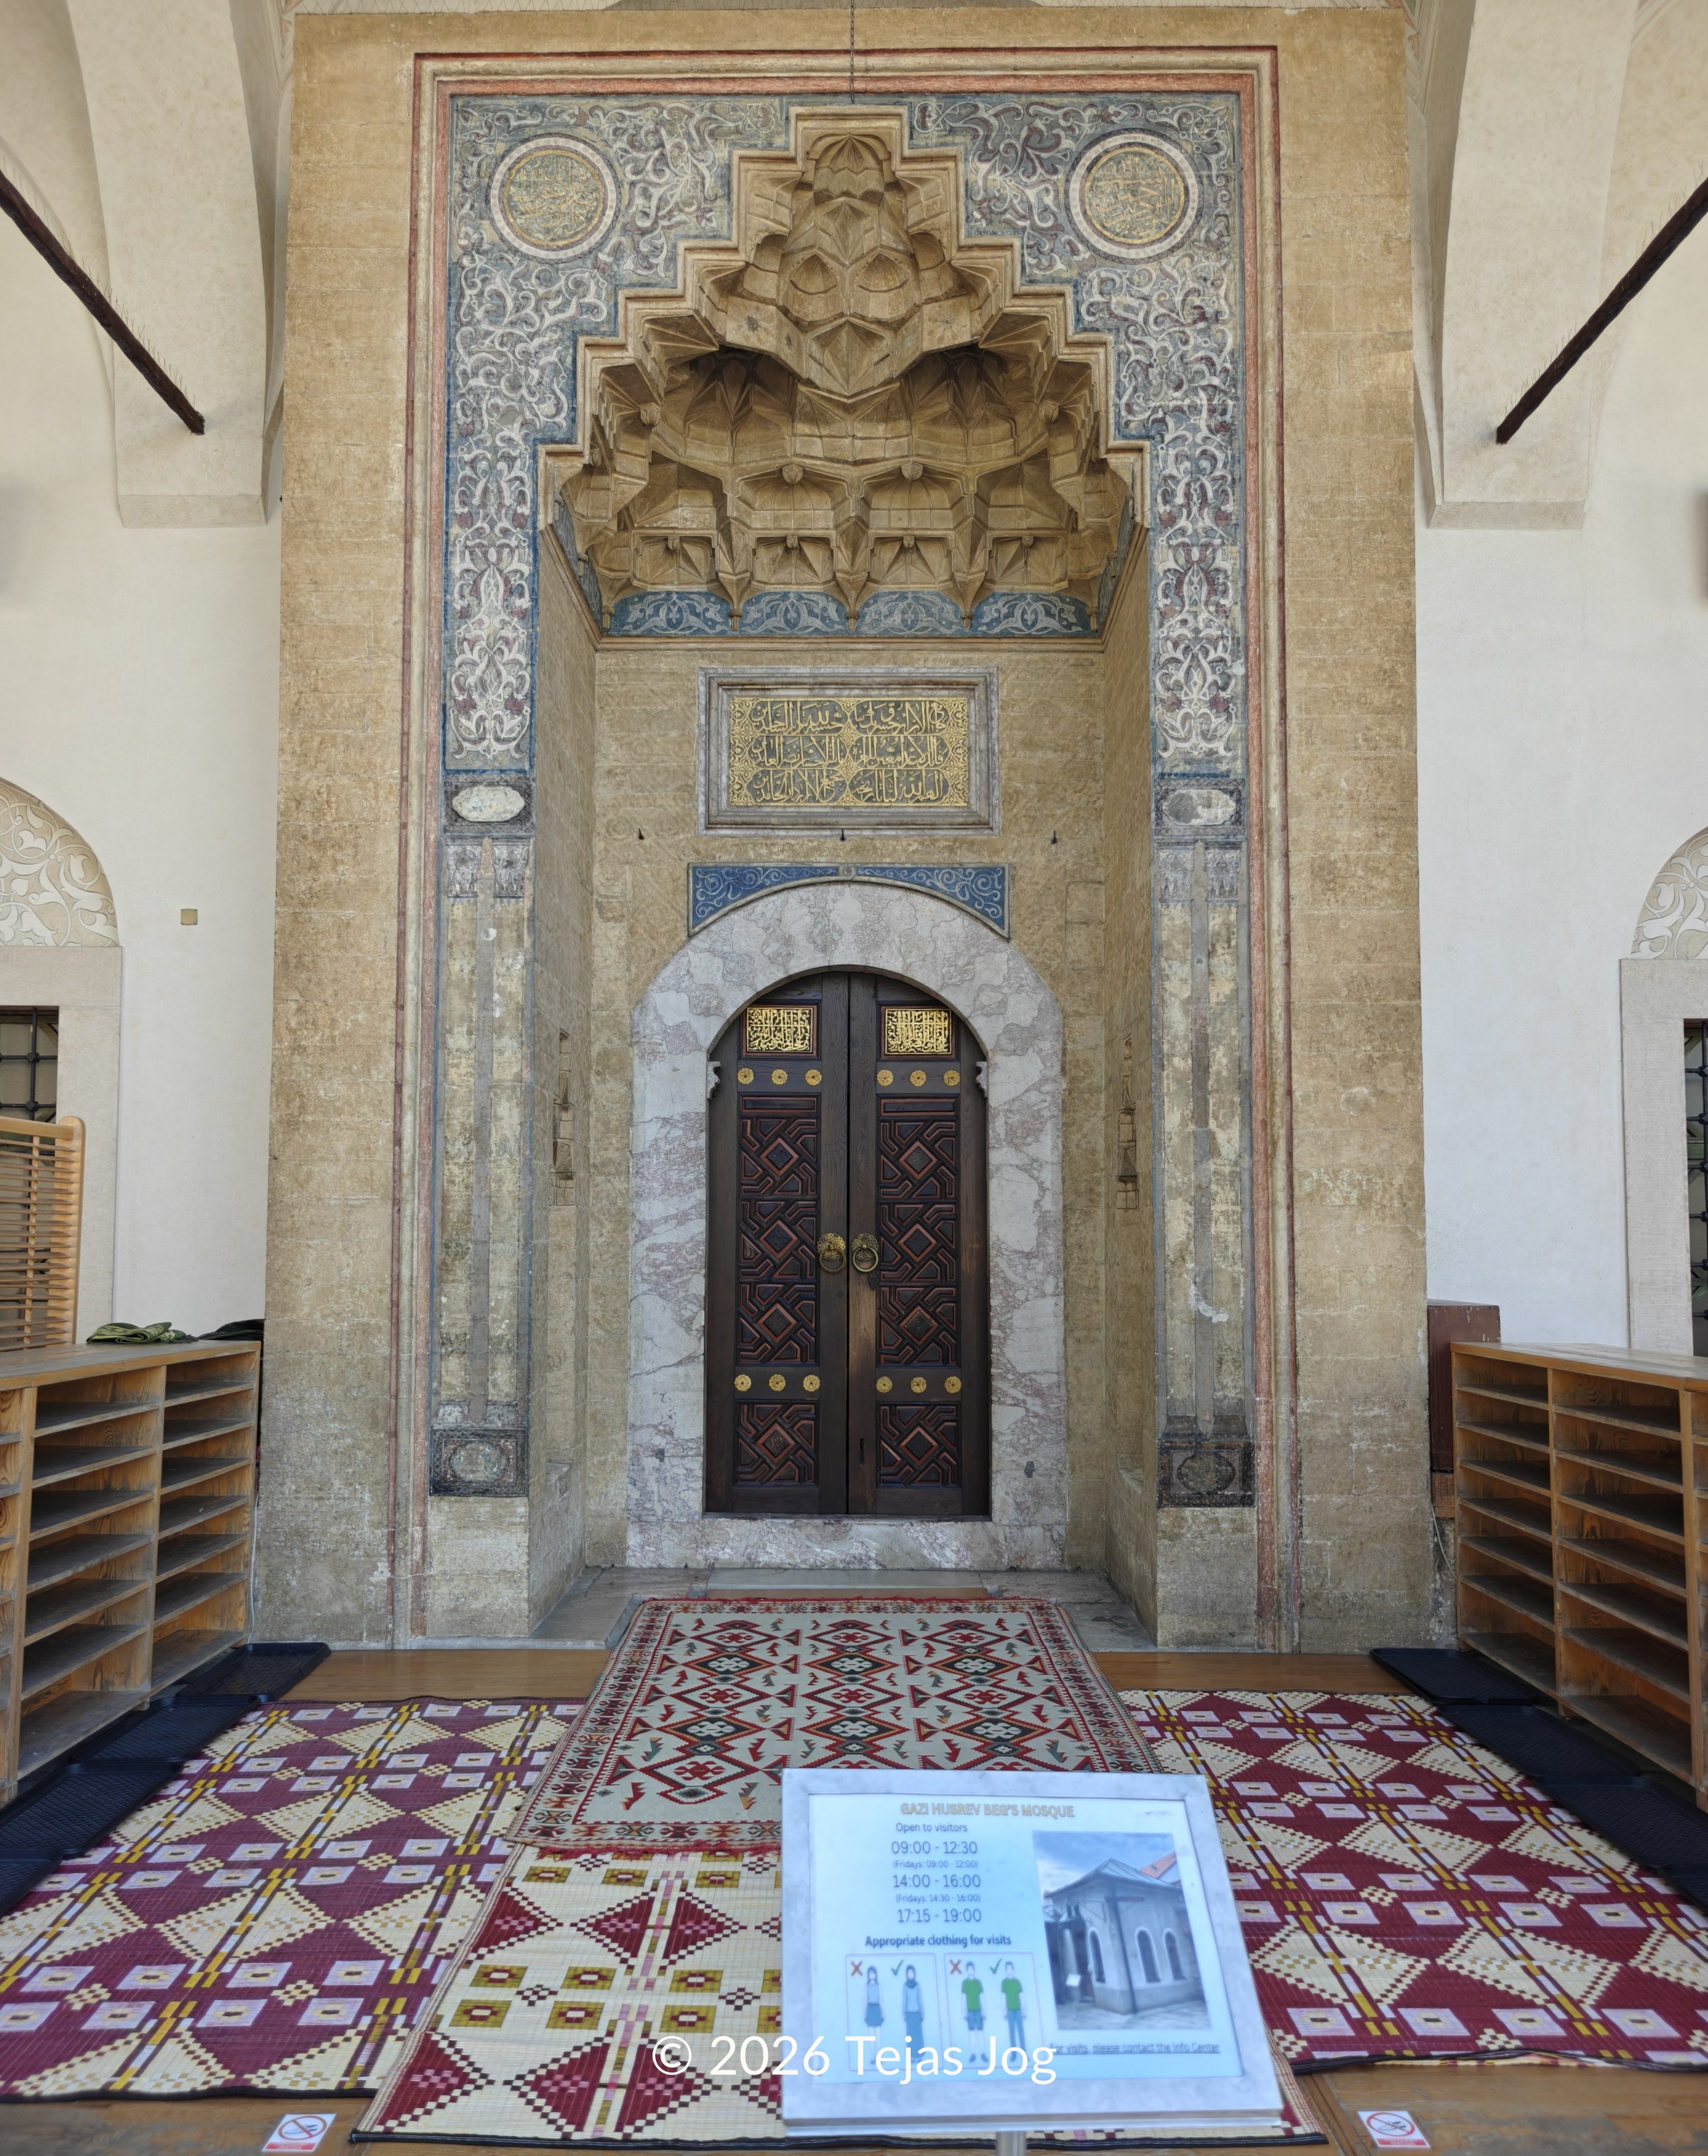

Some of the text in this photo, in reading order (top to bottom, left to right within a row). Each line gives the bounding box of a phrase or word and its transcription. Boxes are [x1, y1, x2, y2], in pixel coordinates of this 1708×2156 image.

[901, 1802, 1075, 1819] GAZI HUSREV BEG'S MOSQUE
[896, 1822, 967, 1833] Open to visitors
[891, 1840, 931, 1854] 09:00
[943, 1840, 977, 1854] 12:30
[893, 1860, 924, 1869] (Fridays:
[926, 1860, 949, 1868] 09:00
[955, 1860, 978, 1868] 12:00)
[893, 1874, 931, 1887] 14:00
[943, 1874, 981, 1887] 16:00
[896, 1894, 927, 1904] (Fridays:
[929, 1894, 950, 1902] 14:30
[957, 1894, 981, 1902] 16:00)
[897, 1908, 931, 1922] 17:15
[943, 1908, 981, 1922] 19:00
[865, 1934, 1011, 1948] Appropriate clothing for visits
[1093, 2043, 1120, 2054] please
[1122, 2043, 1154, 2053] contact
[1156, 2043, 1171, 2052] the
[1192, 2043, 1220, 2053] Center
